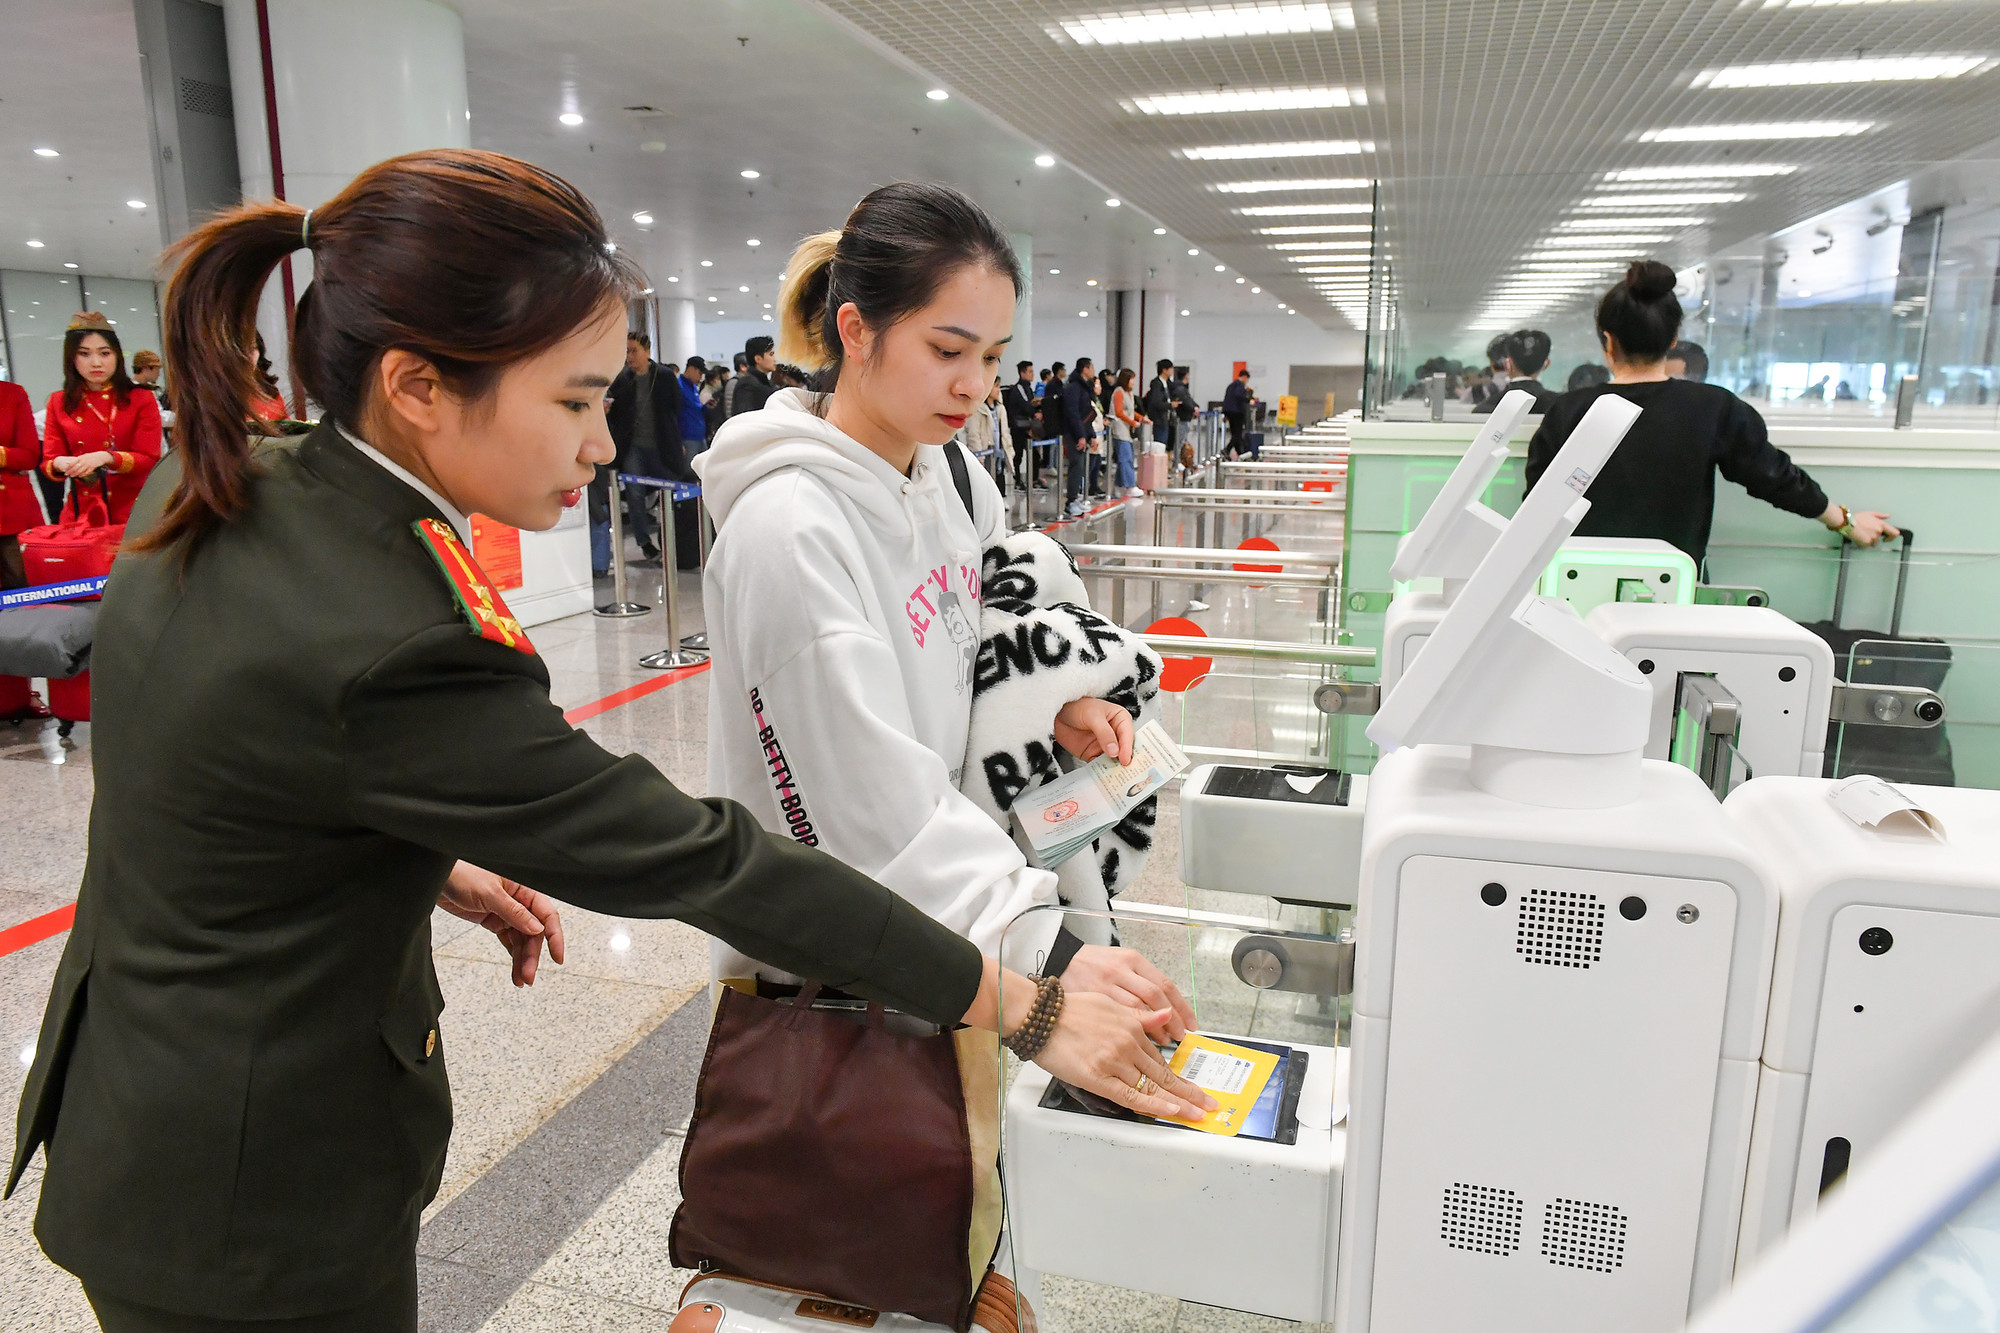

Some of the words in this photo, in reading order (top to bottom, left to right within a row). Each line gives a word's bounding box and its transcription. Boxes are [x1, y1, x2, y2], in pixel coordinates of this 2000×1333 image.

[3, 582, 94, 605] INTERNATIONAL
[759, 725, 796, 790] BETTY
[780, 793, 819, 848] BOOP
